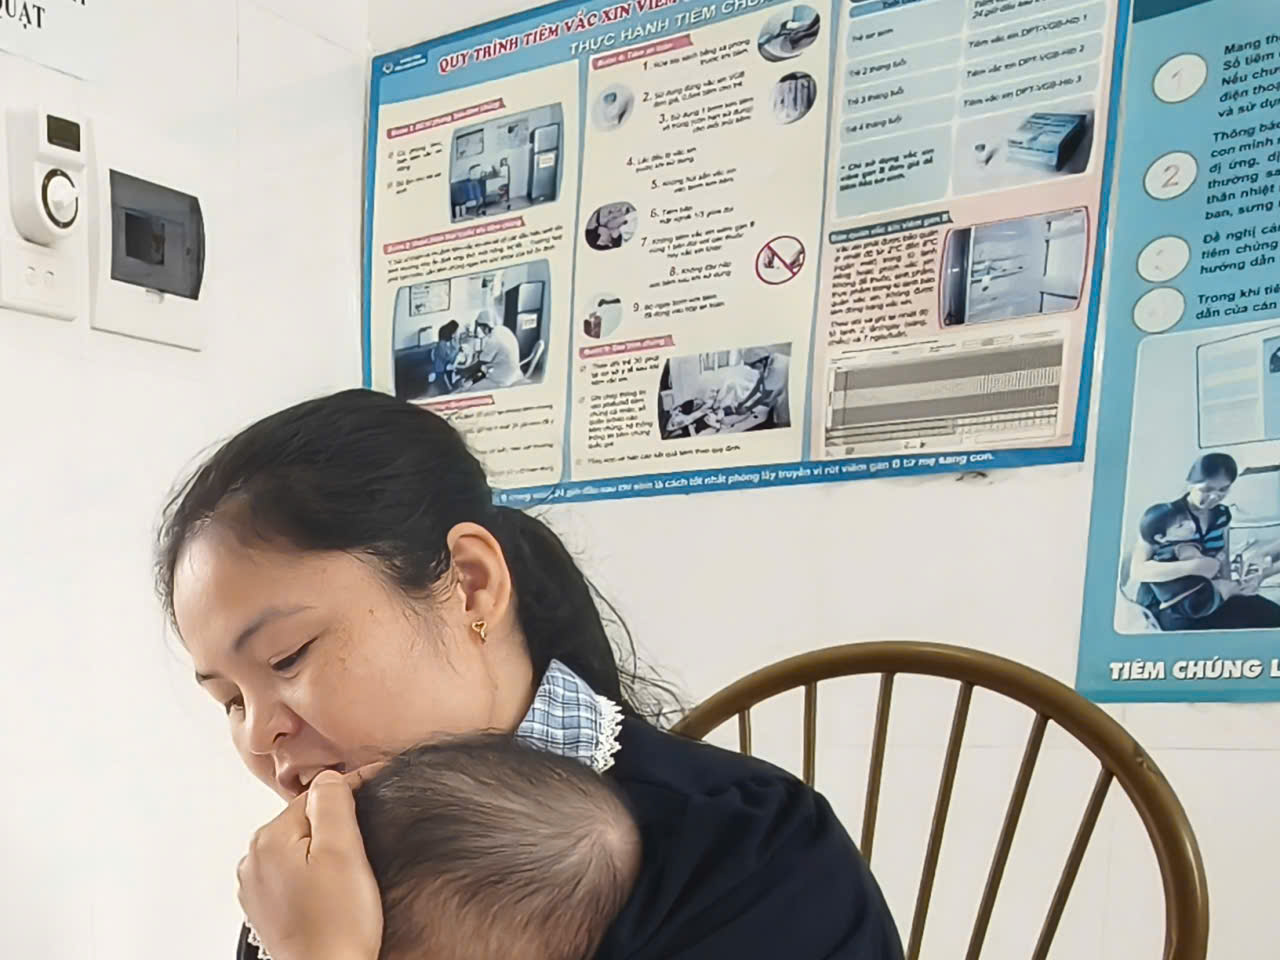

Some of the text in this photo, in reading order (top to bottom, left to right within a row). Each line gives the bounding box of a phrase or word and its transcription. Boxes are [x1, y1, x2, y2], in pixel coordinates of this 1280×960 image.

[620, 17, 669, 40] HÀNH
[439, 52, 471, 74] QUY
[474, 38, 520, 61] TRÌNH
[523, 25, 560, 47] TIÊM
[563, 10, 598, 34] VẮC
[600, 1, 632, 24] XIN
[1224, 34, 1280, 55] Mang th
[1245, 52, 1275, 66] tiêm
[1222, 71, 1248, 87] Nếu
[1220, 89, 1248, 103] điện
[1218, 105, 1233, 117] và
[1213, 127, 1256, 143] Thông
[1211, 146, 1235, 158] con
[1161, 164, 1180, 188] 2
[1208, 173, 1259, 189] thường
[1207, 184, 1275, 205] thân nhiệt
[1205, 201, 1274, 220] ban, sưng
[1226, 226, 1257, 241] nghị
[1201, 247, 1230, 260] tiêm
[1200, 261, 1246, 275] hướng
[1198, 292, 1236, 305] Trong
[1240, 286, 1260, 298] khi
[1224, 304, 1248, 316] của
[665, 478, 688, 488] cách
[728, 472, 760, 484] phòng
[969, 453, 994, 462] con.
[1110, 658, 1166, 680] TIÊM
